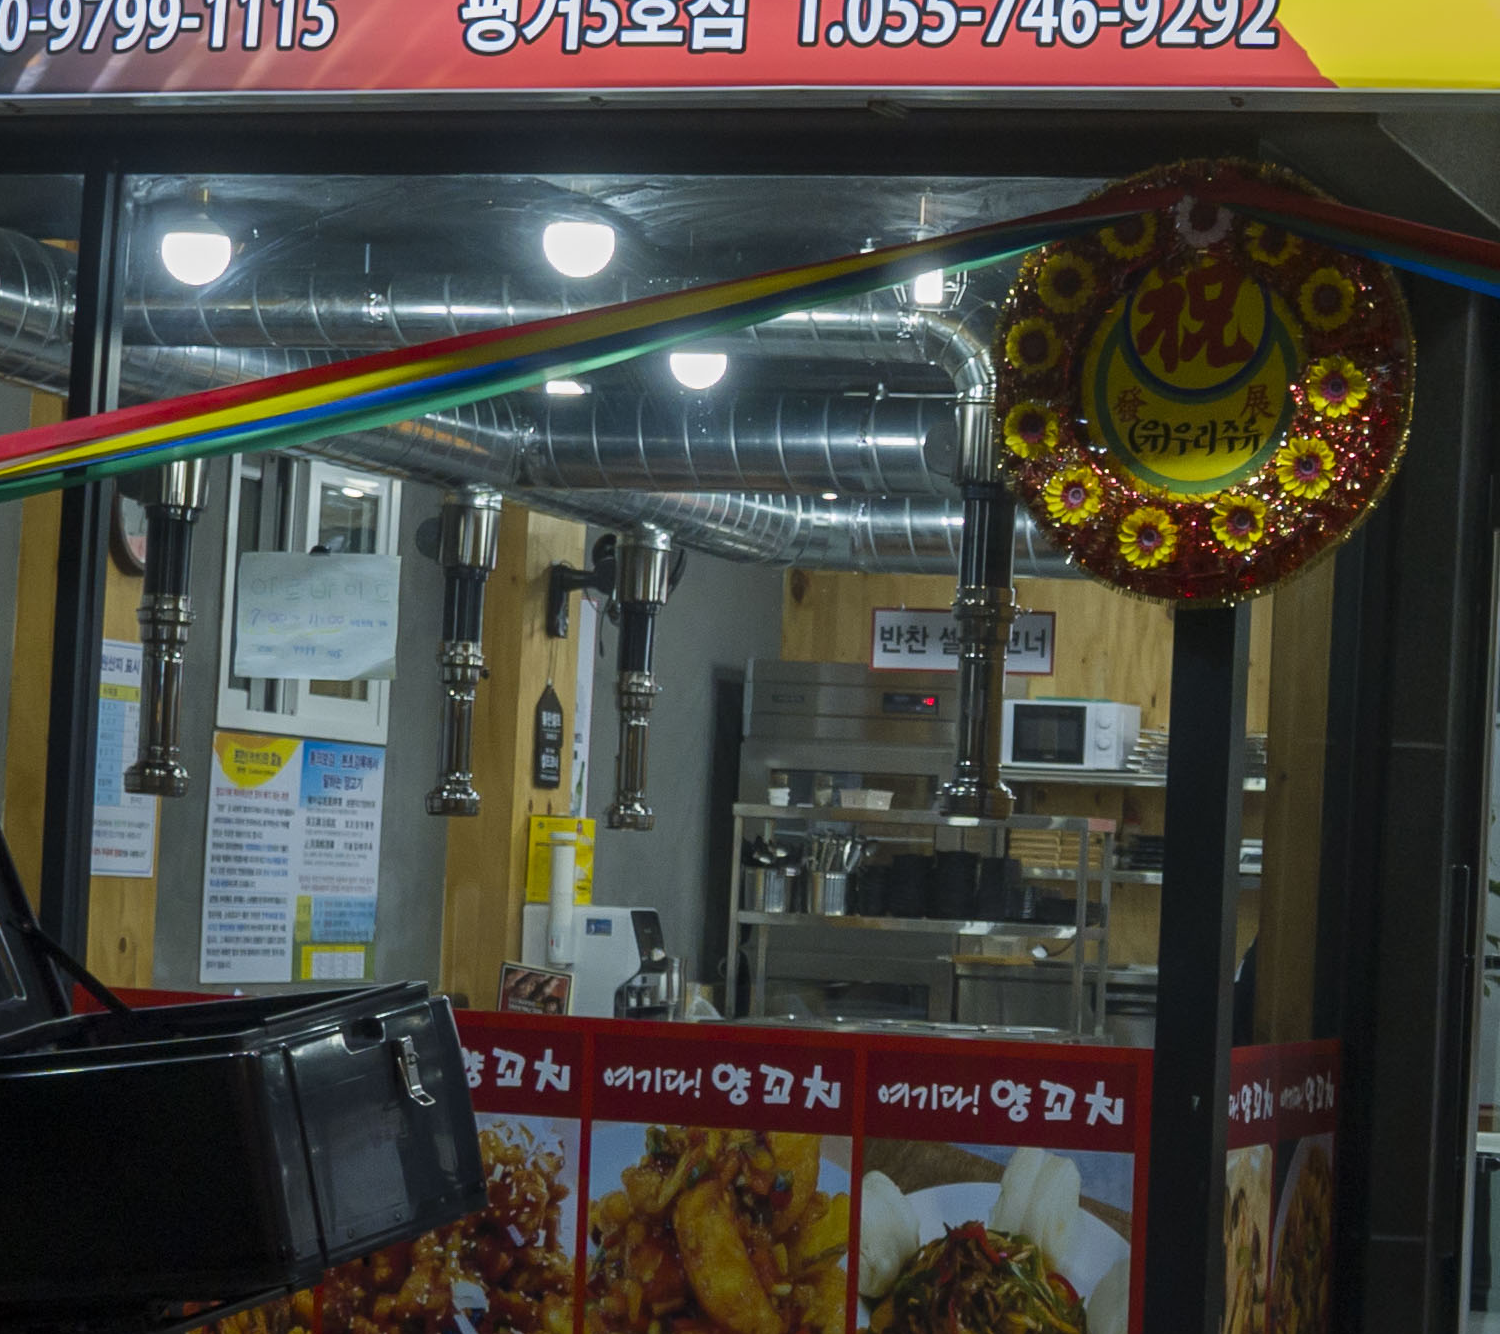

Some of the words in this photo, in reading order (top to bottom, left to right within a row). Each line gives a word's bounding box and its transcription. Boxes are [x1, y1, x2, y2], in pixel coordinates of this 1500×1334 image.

[1137, 266, 1256, 374] 祝
[880, 625, 930, 655] 반찬
[602, 1061, 703, 1099] 여기다!
[711, 1061, 844, 1112] 양꼬치
[877, 1079, 980, 1117] 여기다!
[990, 1078, 1126, 1126] 양꼬치
